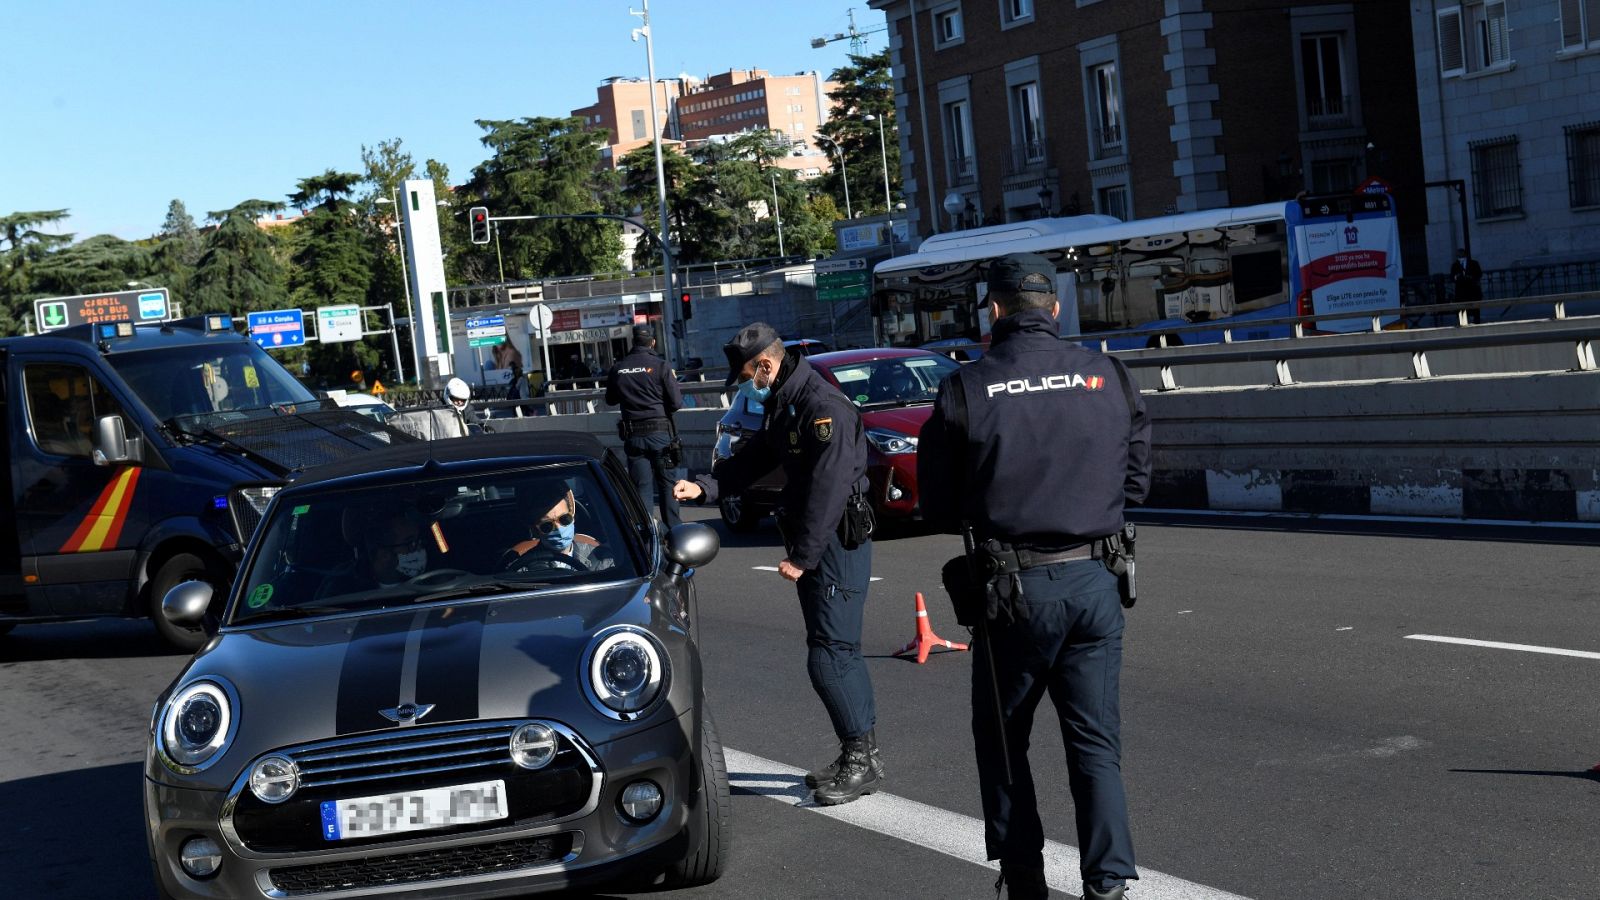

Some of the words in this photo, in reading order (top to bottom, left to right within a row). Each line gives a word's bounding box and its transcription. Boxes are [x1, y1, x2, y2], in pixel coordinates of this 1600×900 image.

[1358, 259, 1378, 268] bastante
[1327, 294, 1340, 302] Elige
[79, 307, 104, 317] SOLO
[109, 304, 128, 314] BUS
[564, 327, 608, 342] MONCLOA
[617, 367, 647, 375] POLICIA
[987, 374, 1087, 398] POLICIA
[328, 824, 335, 833] E
